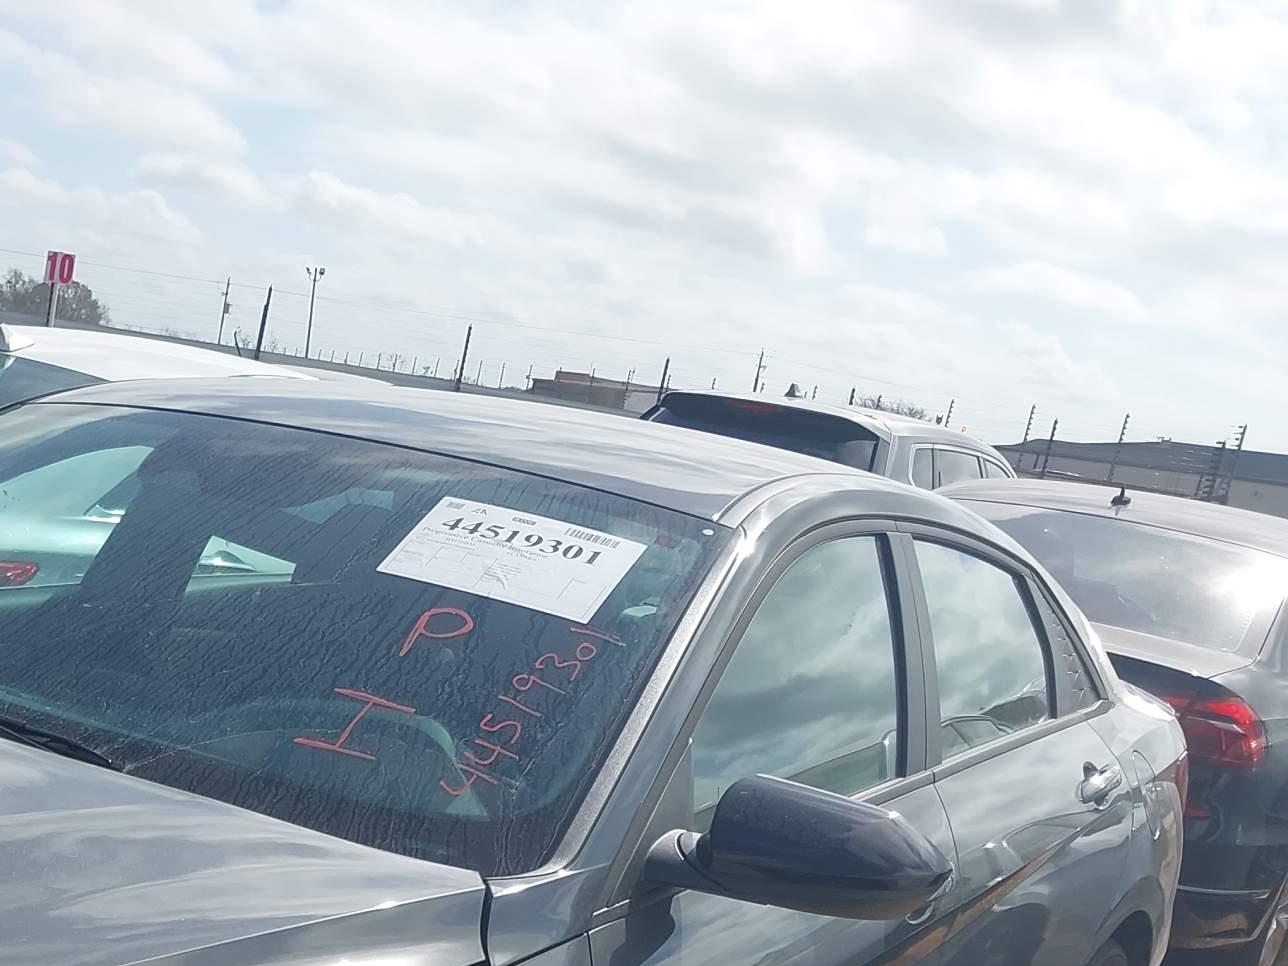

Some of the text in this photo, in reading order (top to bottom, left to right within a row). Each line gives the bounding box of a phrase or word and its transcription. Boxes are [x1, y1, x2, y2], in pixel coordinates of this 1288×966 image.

[48, 253, 73, 283] 10
[442, 517, 603, 565] 44519301
[439, 626, 626, 795] 44519301
